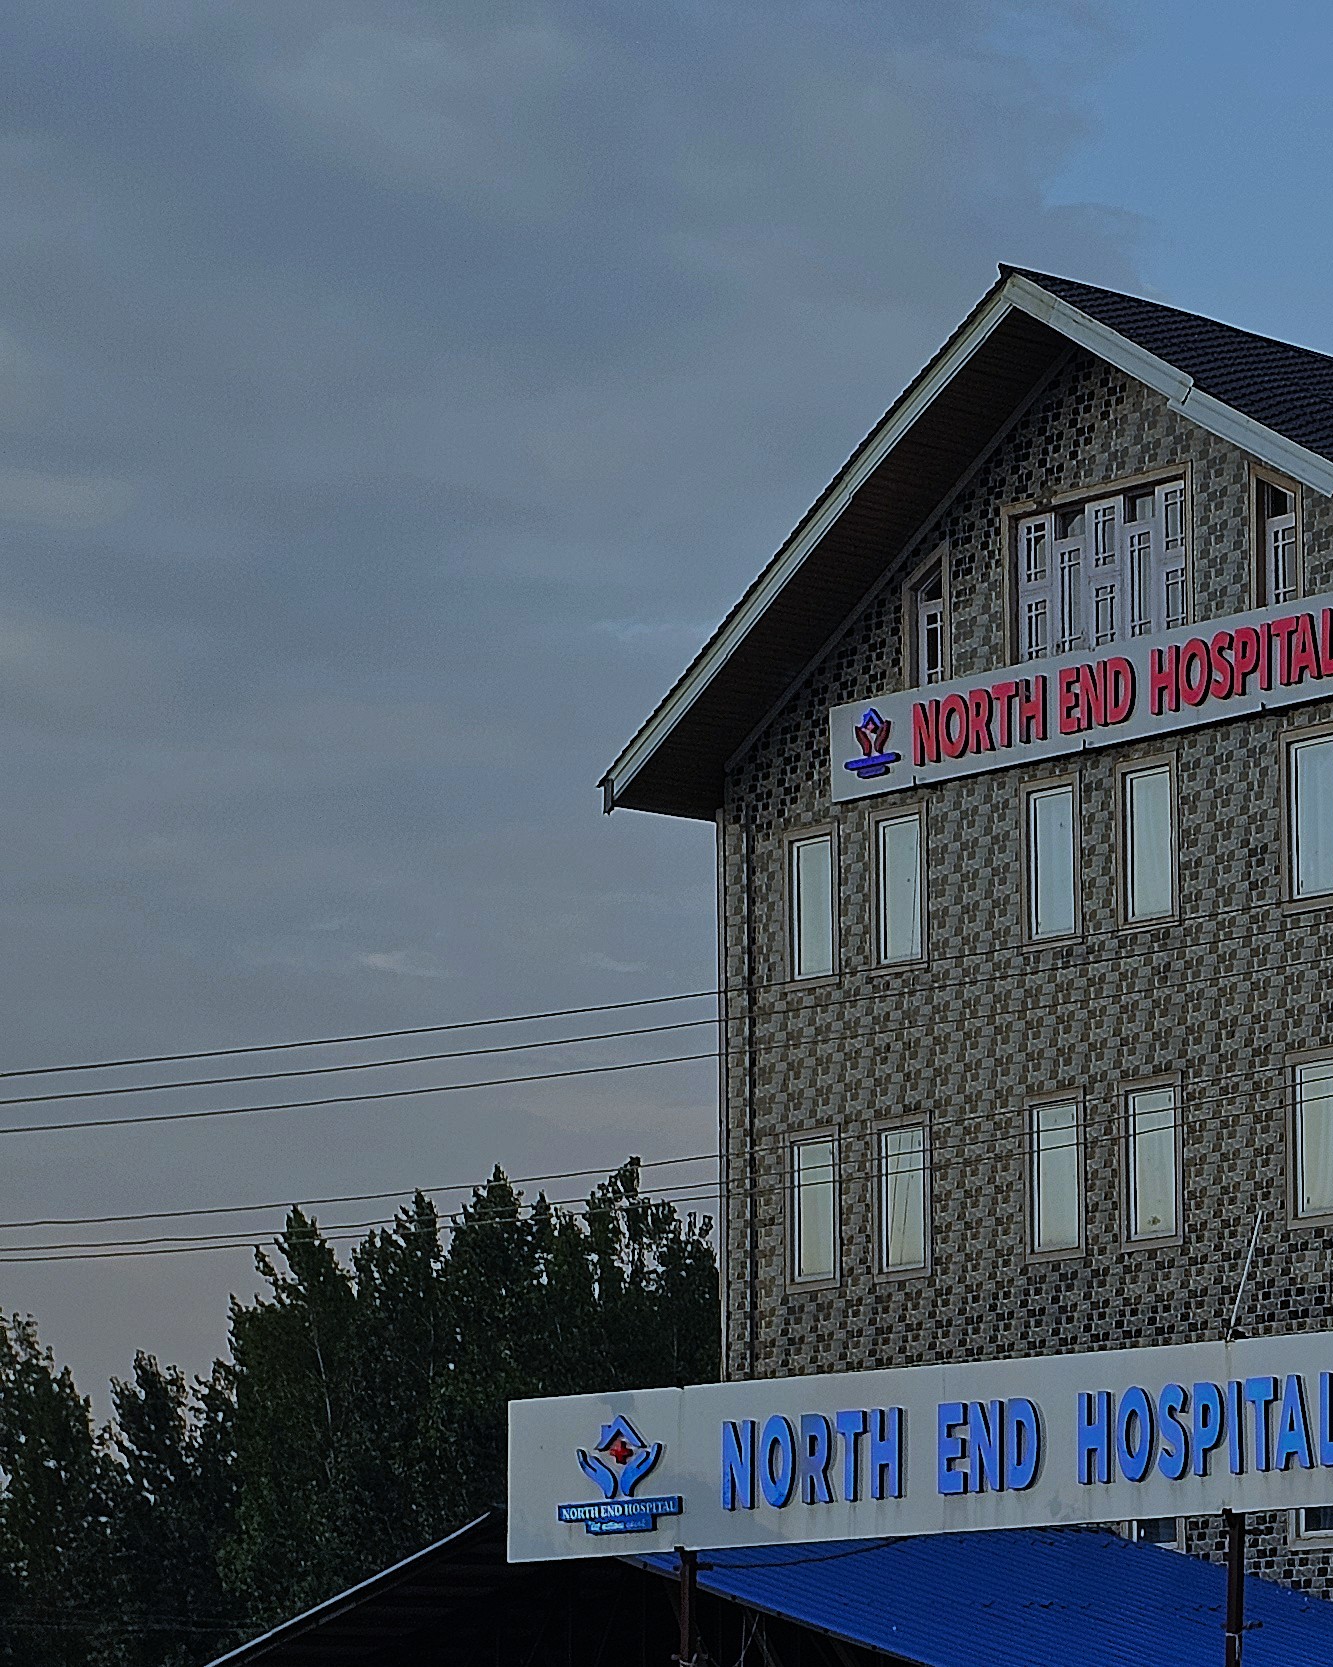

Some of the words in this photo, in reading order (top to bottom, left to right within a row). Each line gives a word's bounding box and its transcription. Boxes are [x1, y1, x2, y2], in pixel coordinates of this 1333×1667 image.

[912, 675, 1047, 766] NORTH
[1059, 656, 1136, 733] END
[721, 1406, 905, 1510] NORTH
[937, 1397, 1042, 1495] END
[562, 1506, 598, 1520] NORTH
[600, 1504, 623, 1518] END
[624, 1501, 674, 1515] HOSPITAL
